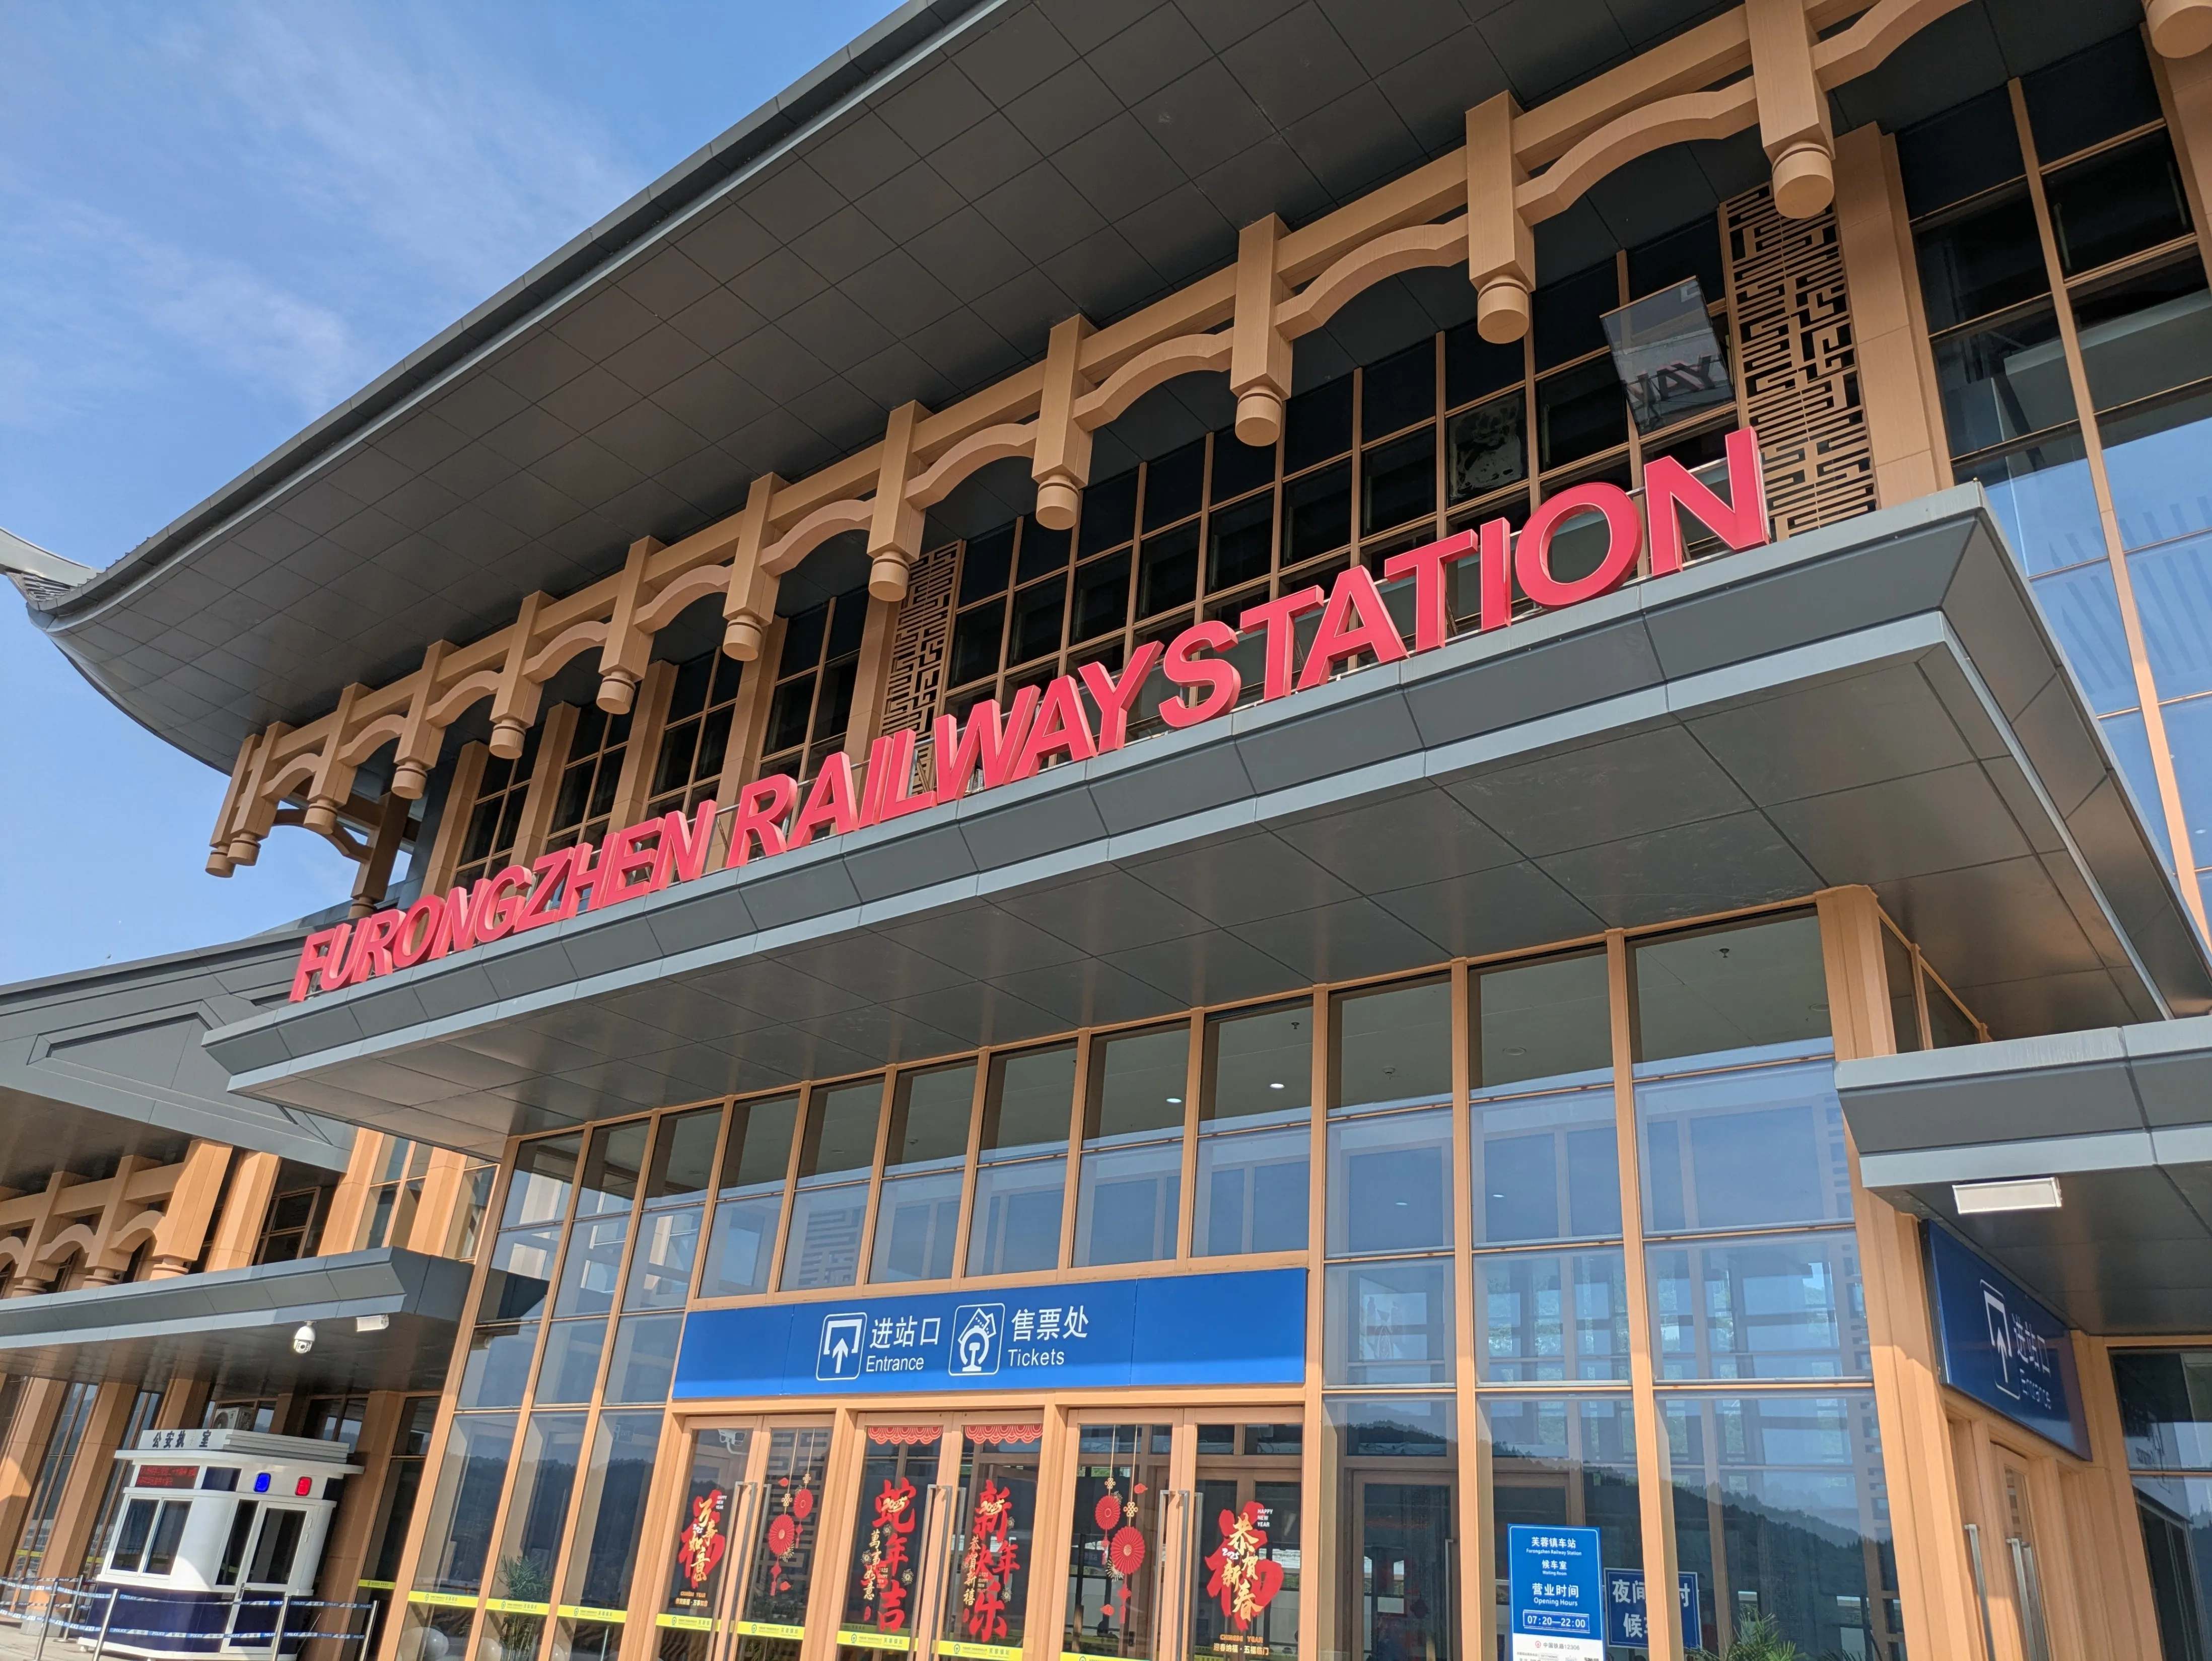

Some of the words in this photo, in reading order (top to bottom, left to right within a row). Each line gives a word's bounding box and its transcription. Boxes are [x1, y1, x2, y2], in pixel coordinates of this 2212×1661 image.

[289, 799, 718, 1003] FURONGZHEN
[869, 1316, 941, 1349] 进站口
[1011, 1305, 1089, 1342] 售票处
[2011, 1312, 2052, 1378] 进站口
[866, 1355, 924, 1372] Entrance
[1008, 1349, 1065, 1366] Tickets
[152, 1429, 212, 1448] 公安执室
[1532, 1537, 1576, 1549] 芙蓉镇车站
[1222, 1547, 1240, 1560] 2025
[1542, 1559, 1567, 1570] 候车室
[1532, 1582, 1579, 1598] 营业时间
[1534, 1597, 1559, 1607] Opening
[1560, 1599, 1578, 1607] Hours
